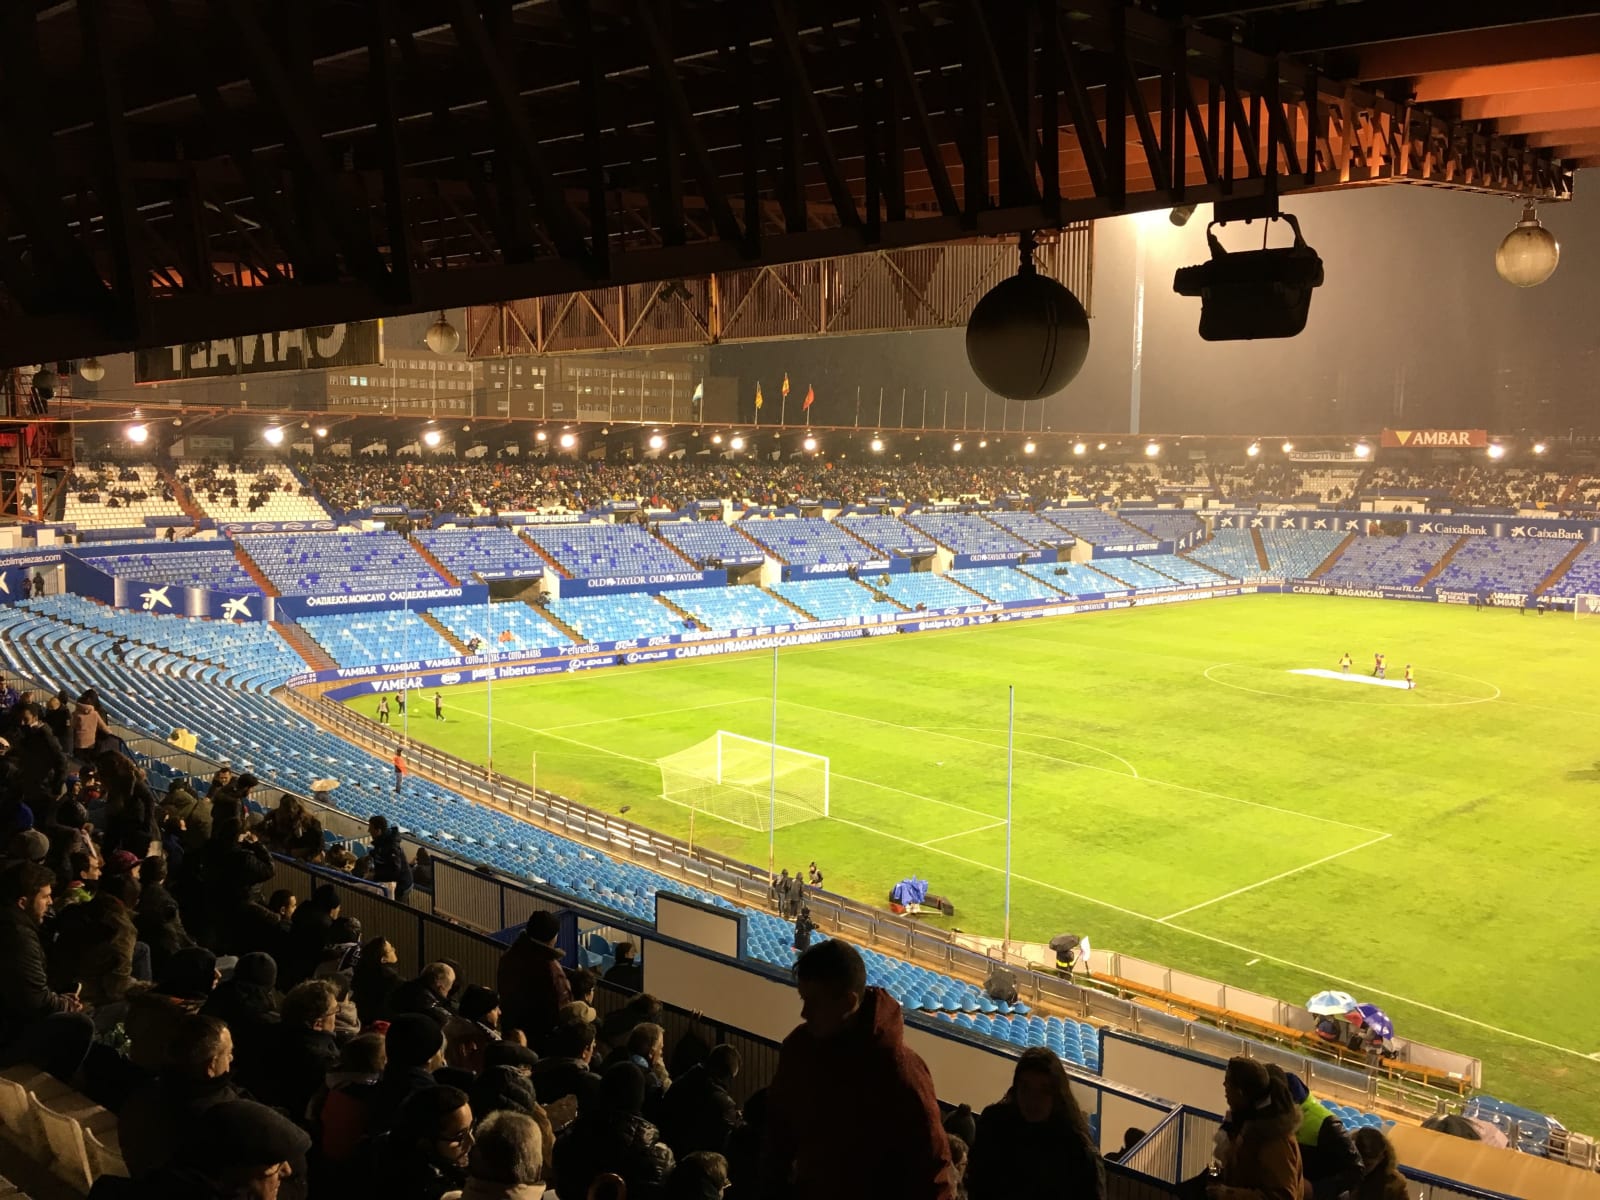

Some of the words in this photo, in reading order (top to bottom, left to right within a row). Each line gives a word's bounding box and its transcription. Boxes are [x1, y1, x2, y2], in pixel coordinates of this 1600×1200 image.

[1412, 432, 1471, 445] AMBAR
[1434, 522, 1487, 536] CaixaBank
[1527, 527, 1584, 541] CaixaBank
[588, 578, 606, 588] OLD
[616, 575, 646, 586] TAYLOR
[649, 575, 666, 585] OLD
[675, 572, 703, 582] TAYLOR
[315, 594, 348, 605] AZULEJOS
[350, 592, 386, 603] MONCAYO
[398, 590, 428, 601] AZULEJOS
[429, 588, 462, 599] MONCAYO
[1333, 588, 1384, 599] FRAGANCIAS
[675, 643, 724, 658] CARAVAN
[725, 638, 779, 652] FRAGANCIAS
[430, 657, 462, 668] AMBAR
[465, 655, 478, 665] COTO
[508, 652, 522, 661] COTO
[345, 665, 376, 677] AMBAR
[387, 661, 420, 673] AMBAR
[499, 665, 536, 677] hiberus
[380, 677, 424, 692] AMBAR
